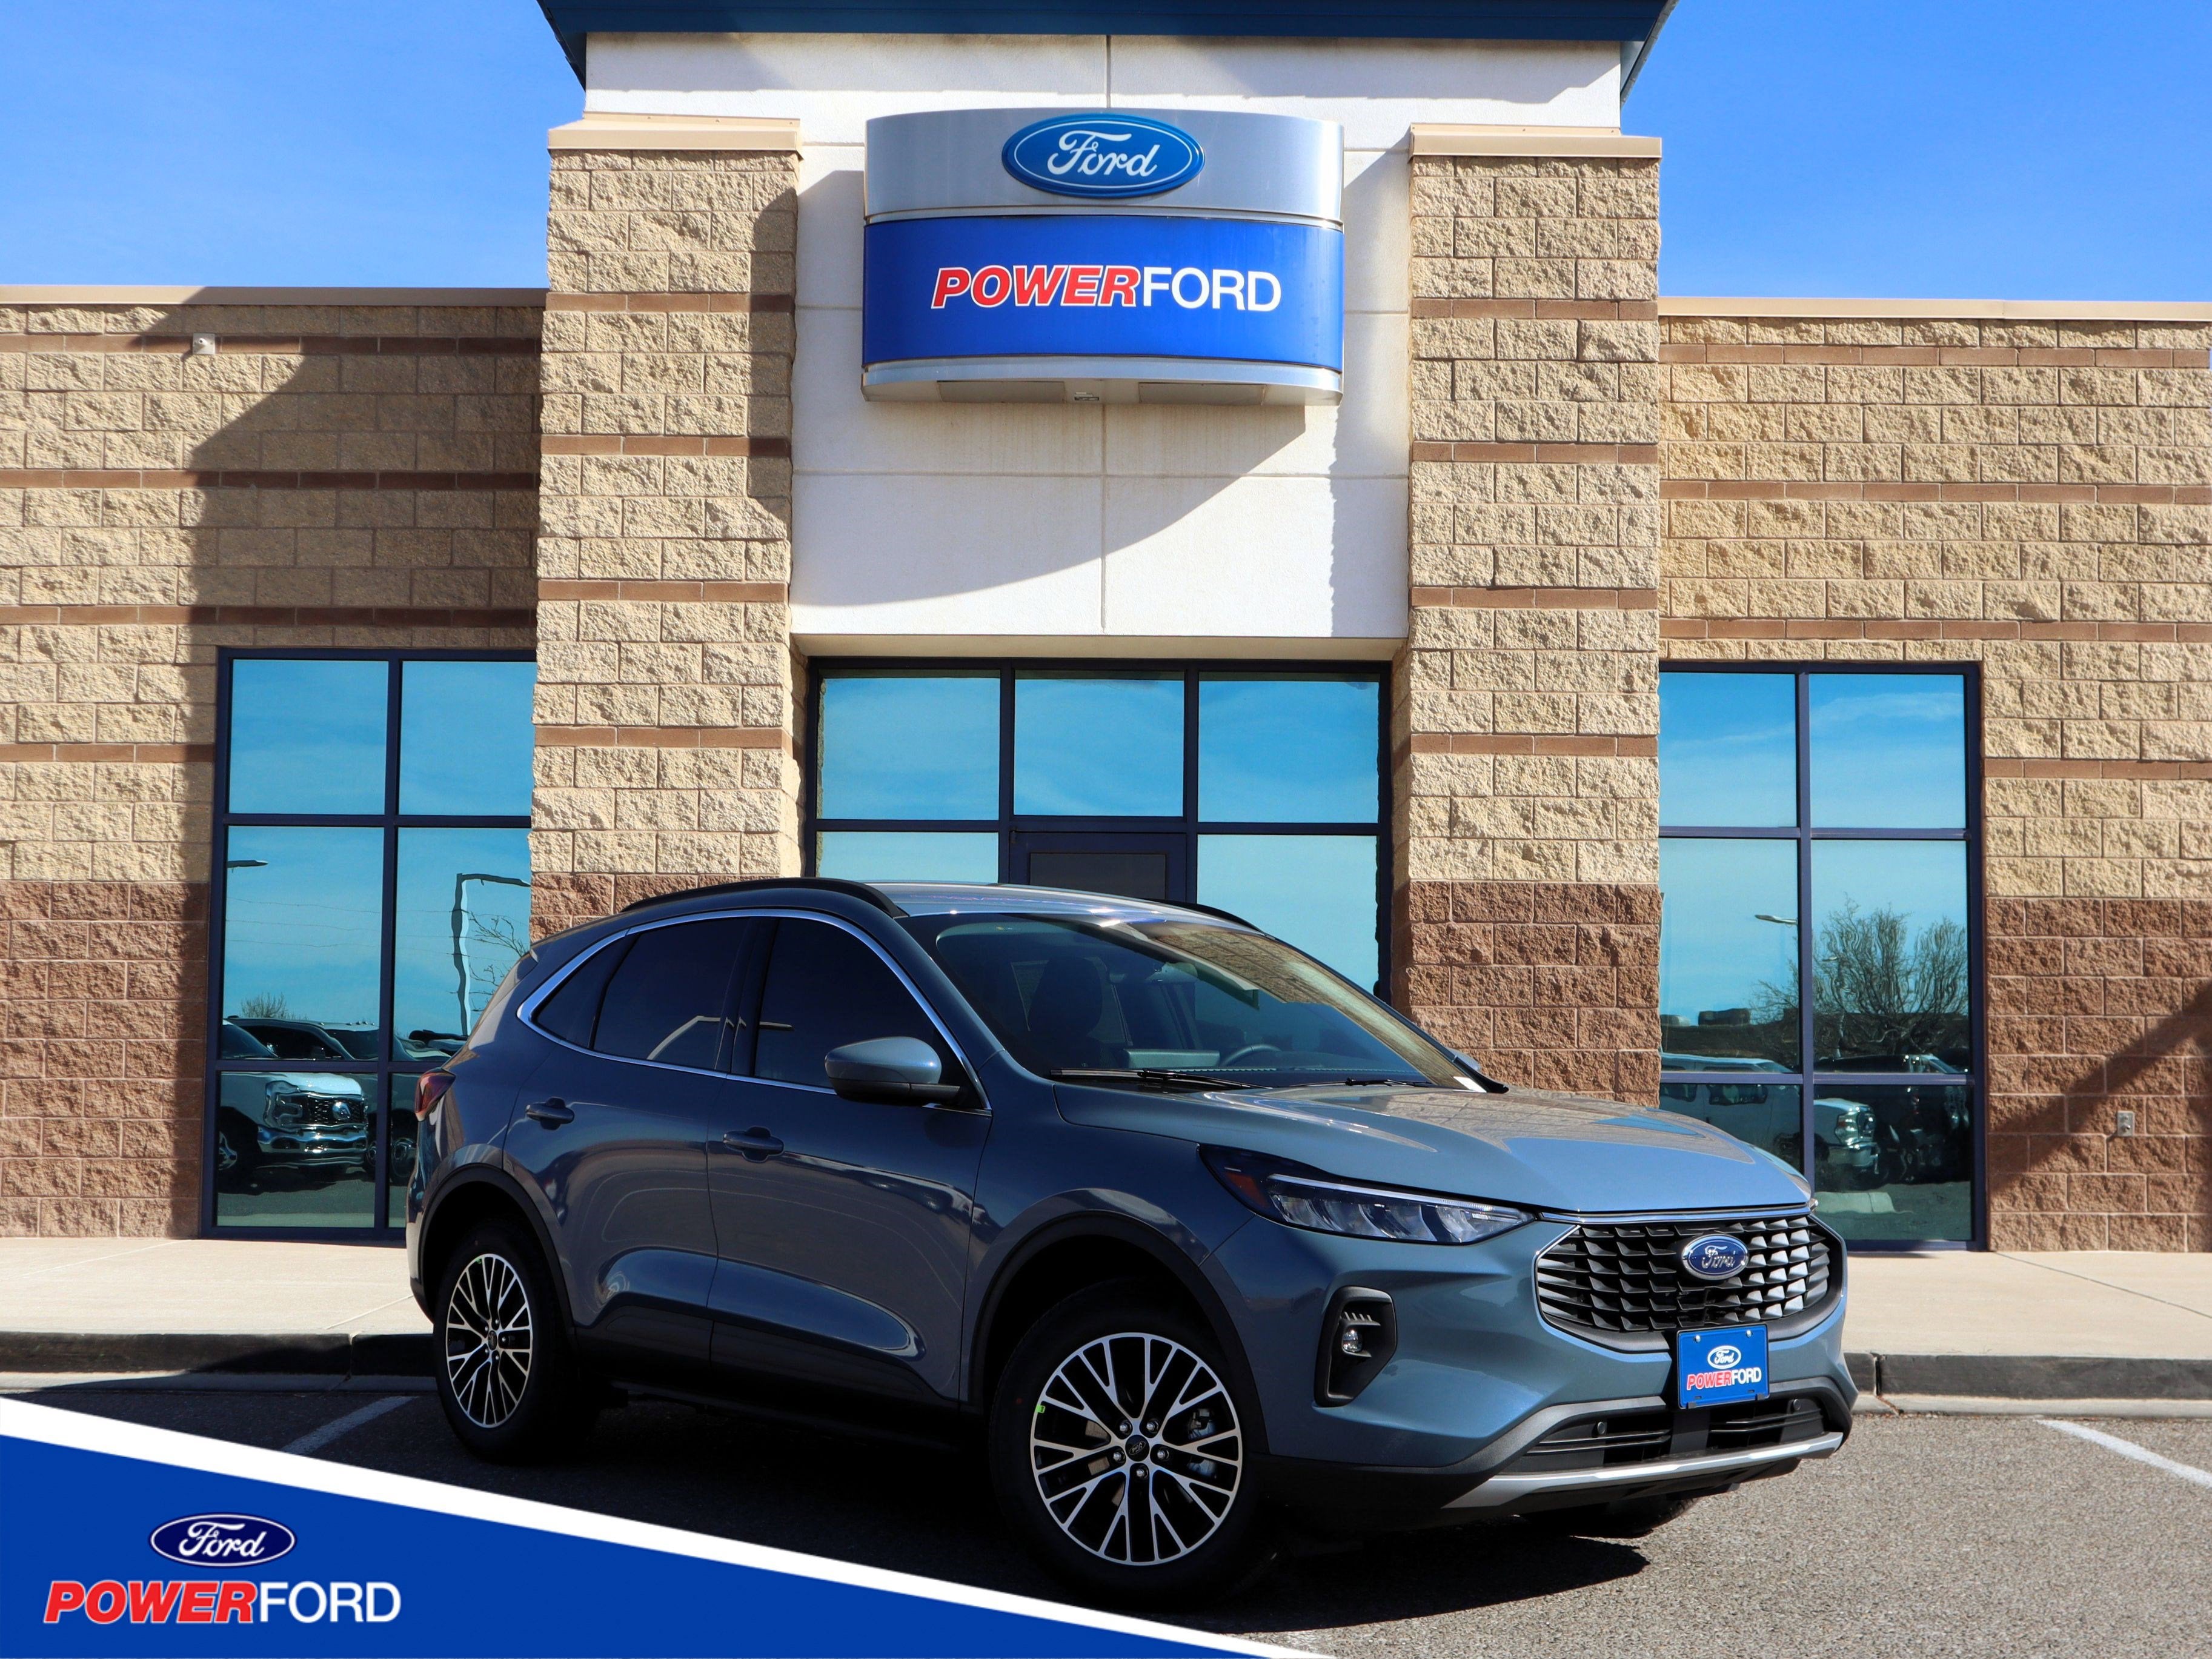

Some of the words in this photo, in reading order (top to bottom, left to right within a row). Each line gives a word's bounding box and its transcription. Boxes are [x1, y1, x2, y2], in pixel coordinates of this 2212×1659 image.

[1047, 129, 1160, 178] Ford
[931, 264, 1282, 311] POWERFORD
[1701, 1245, 1736, 1269] Ford
[1714, 1349, 1735, 1364] Ford
[1686, 1367, 1762, 1391] POWERFORD
